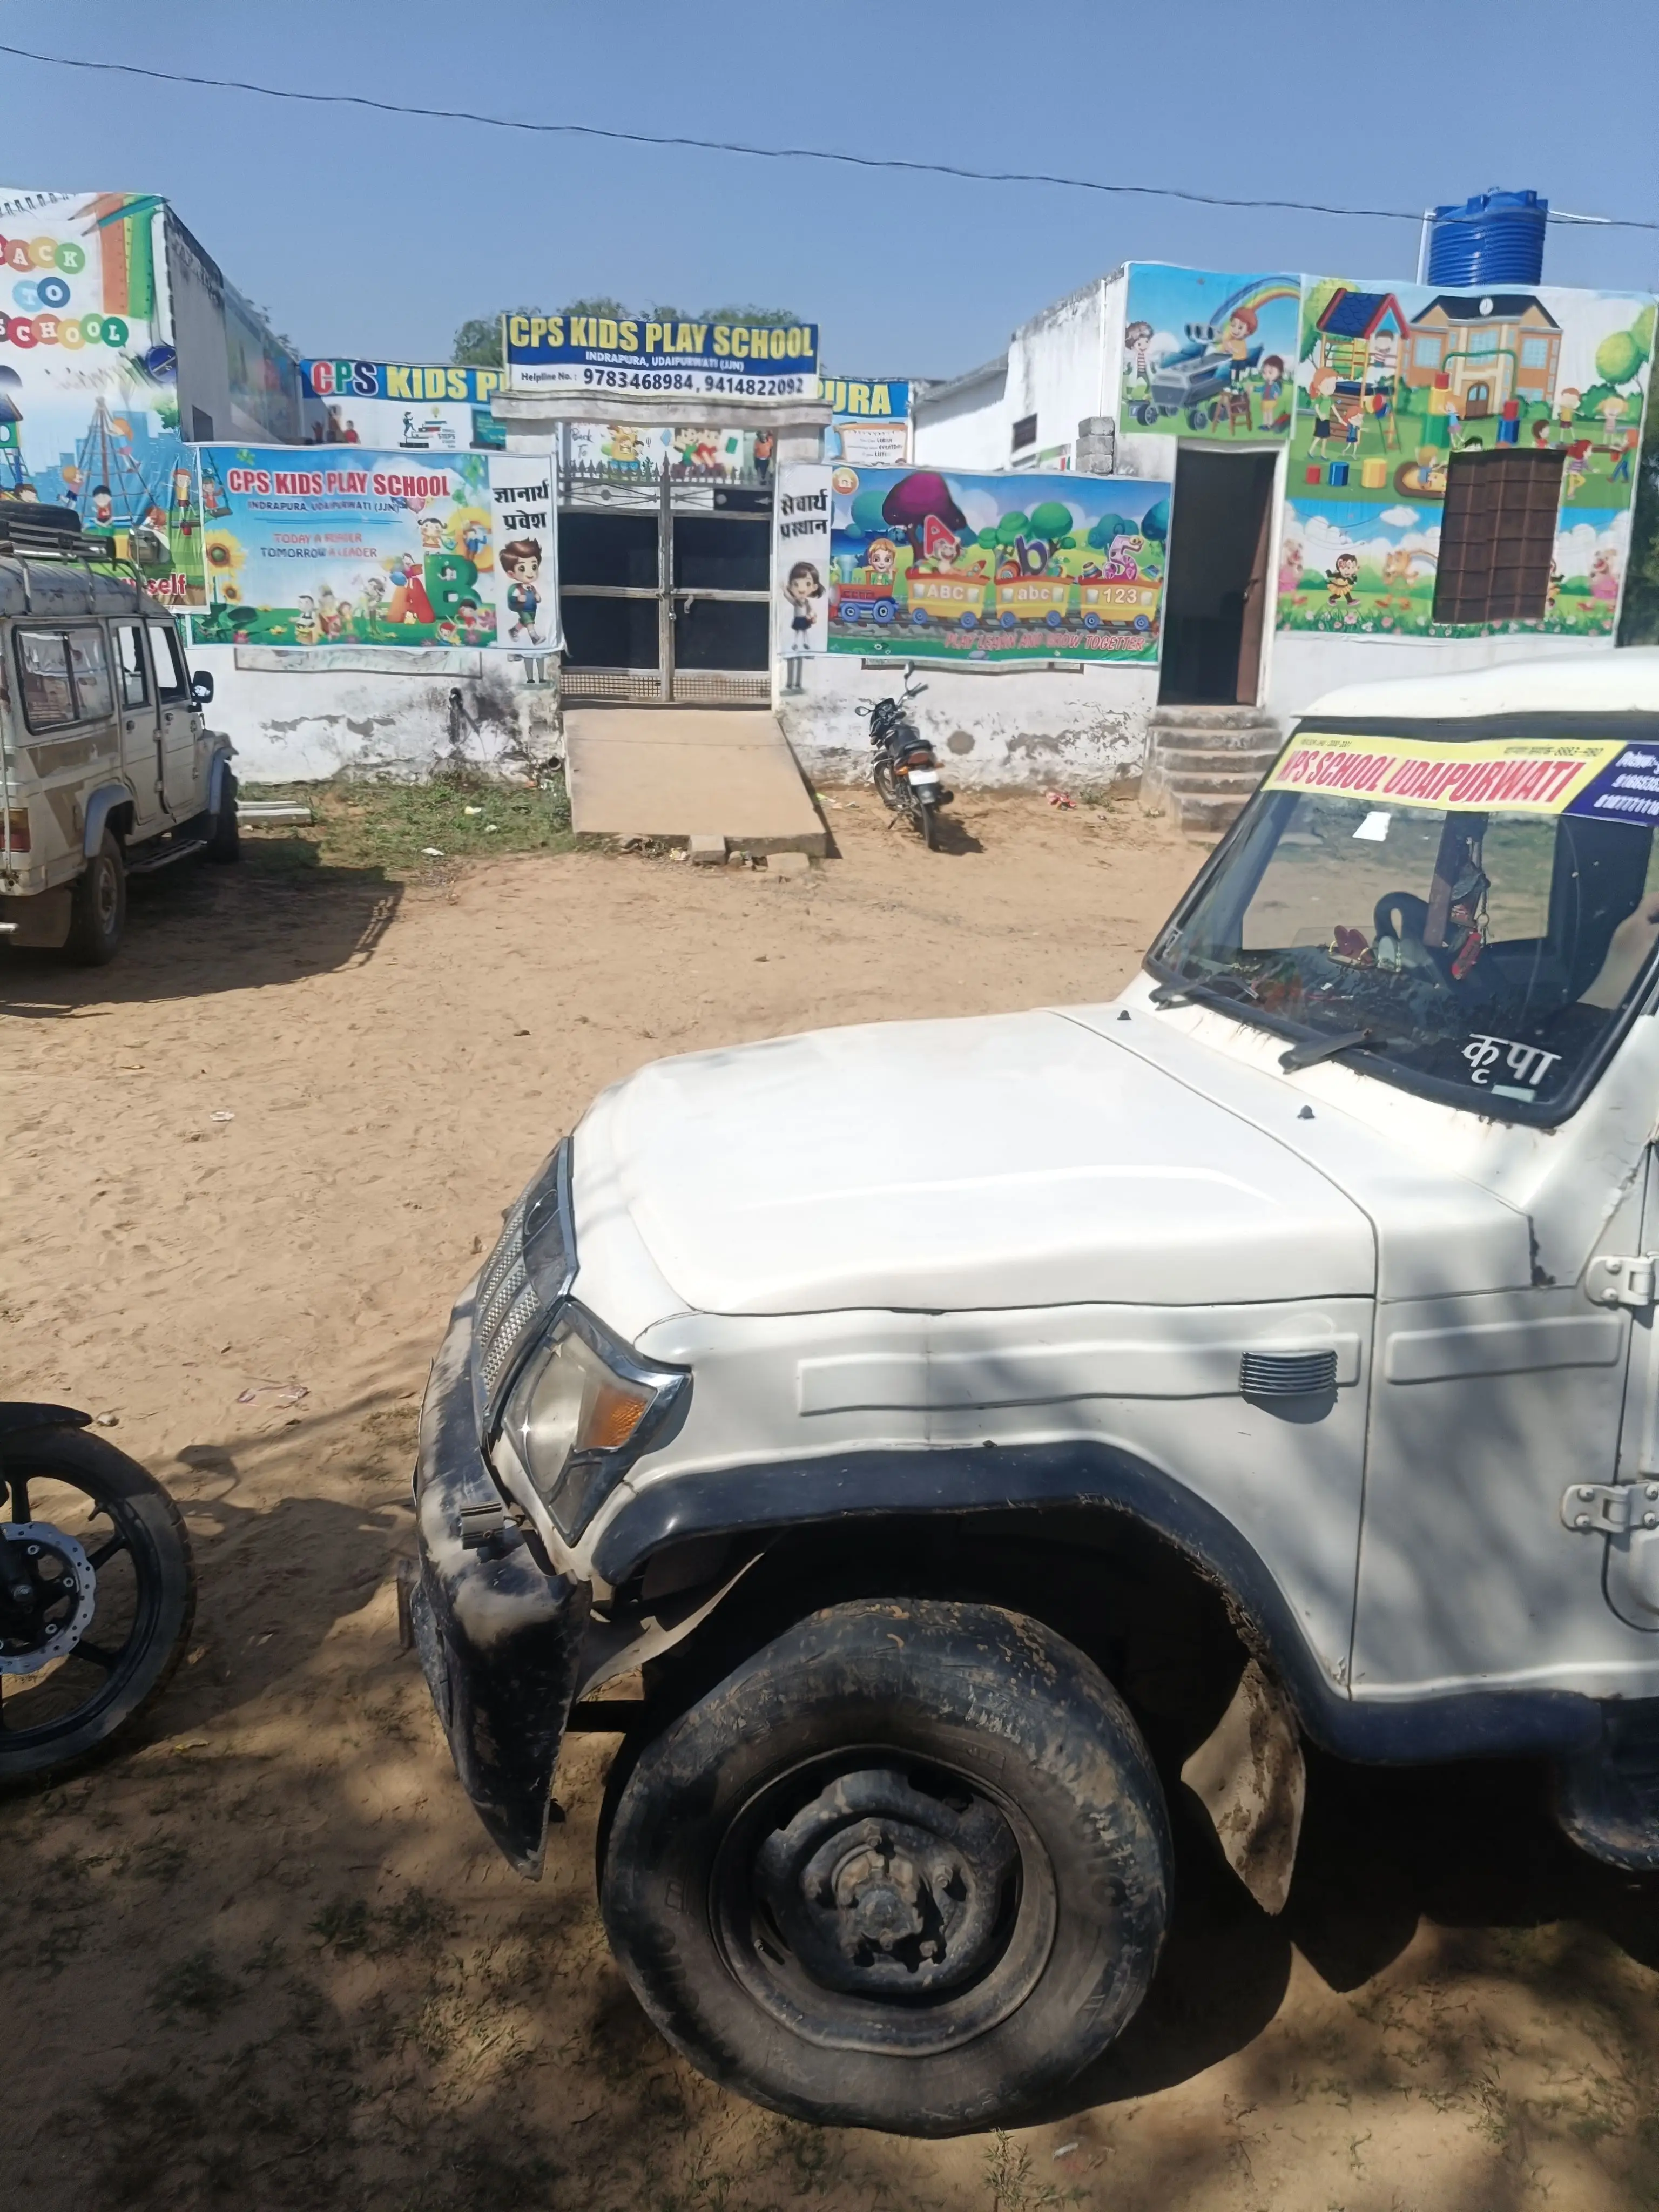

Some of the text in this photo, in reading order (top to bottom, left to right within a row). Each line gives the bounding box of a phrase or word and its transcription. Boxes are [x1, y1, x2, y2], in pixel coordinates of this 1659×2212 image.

[21, 285, 63, 306] TO
[509, 316, 814, 360] CPS KIDS PLAY SCHOOL
[585, 350, 649, 367] INDRAPURA,
[312, 361, 379, 396] CPS
[386, 365, 468, 400] KIDS
[704, 375, 805, 396] 9414822092
[229, 469, 451, 497] CPS KIDS PLAY SCHOOL
[780, 488, 828, 517] सेवार्थ
[502, 509, 547, 530] प्रवेश
[274, 533, 311, 544] TODAY
[314, 534, 322, 543] A
[260, 547, 327, 558] TOMORROW
[927, 585, 964, 601] ABC
[1017, 585, 1050, 601] abc
[1103, 588, 1137, 604] 123
[1305, 751, 1397, 791] SCHOOL
[1382, 759, 1587, 803] UDAIPURWATI
[1461, 1033, 1562, 1085] कृपा
